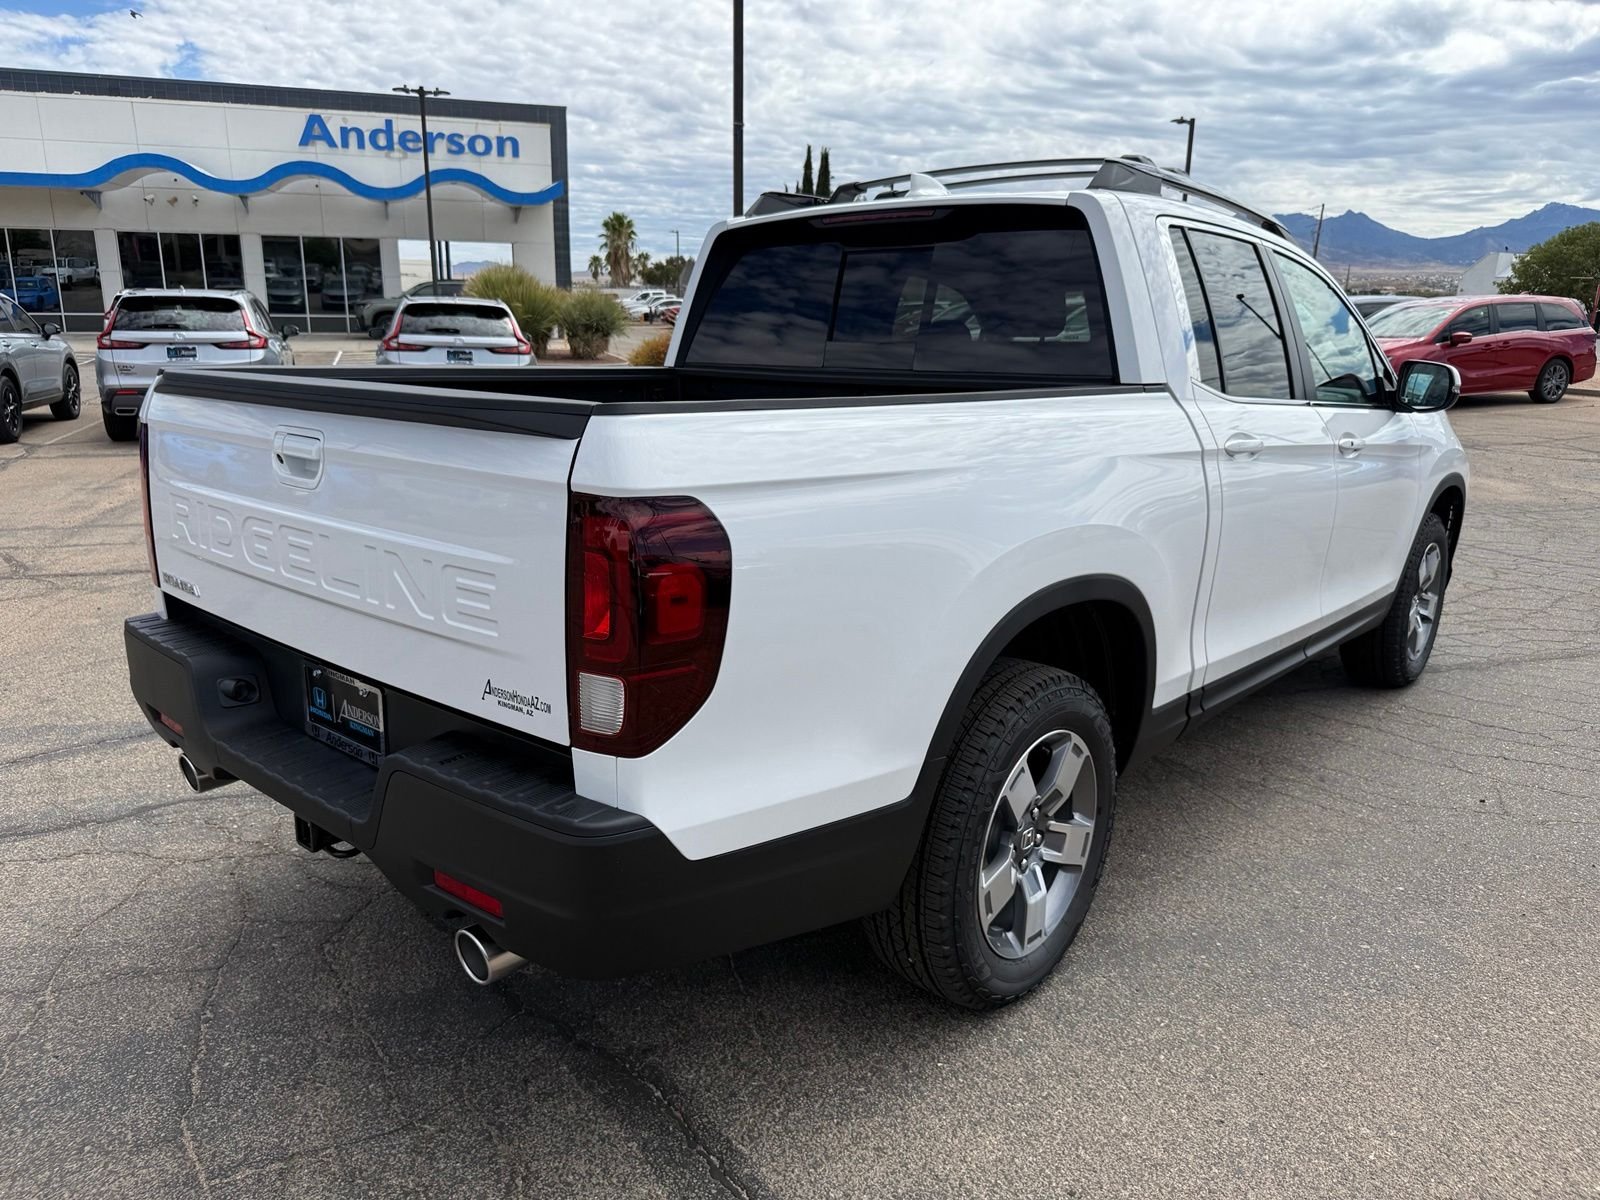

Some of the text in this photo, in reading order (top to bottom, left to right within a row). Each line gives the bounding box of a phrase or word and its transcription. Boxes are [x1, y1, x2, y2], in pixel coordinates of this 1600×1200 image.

[298, 113, 520, 159] Anderson
[168, 492, 499, 637] RIDGELINE
[526, 708, 535, 718] AZ
